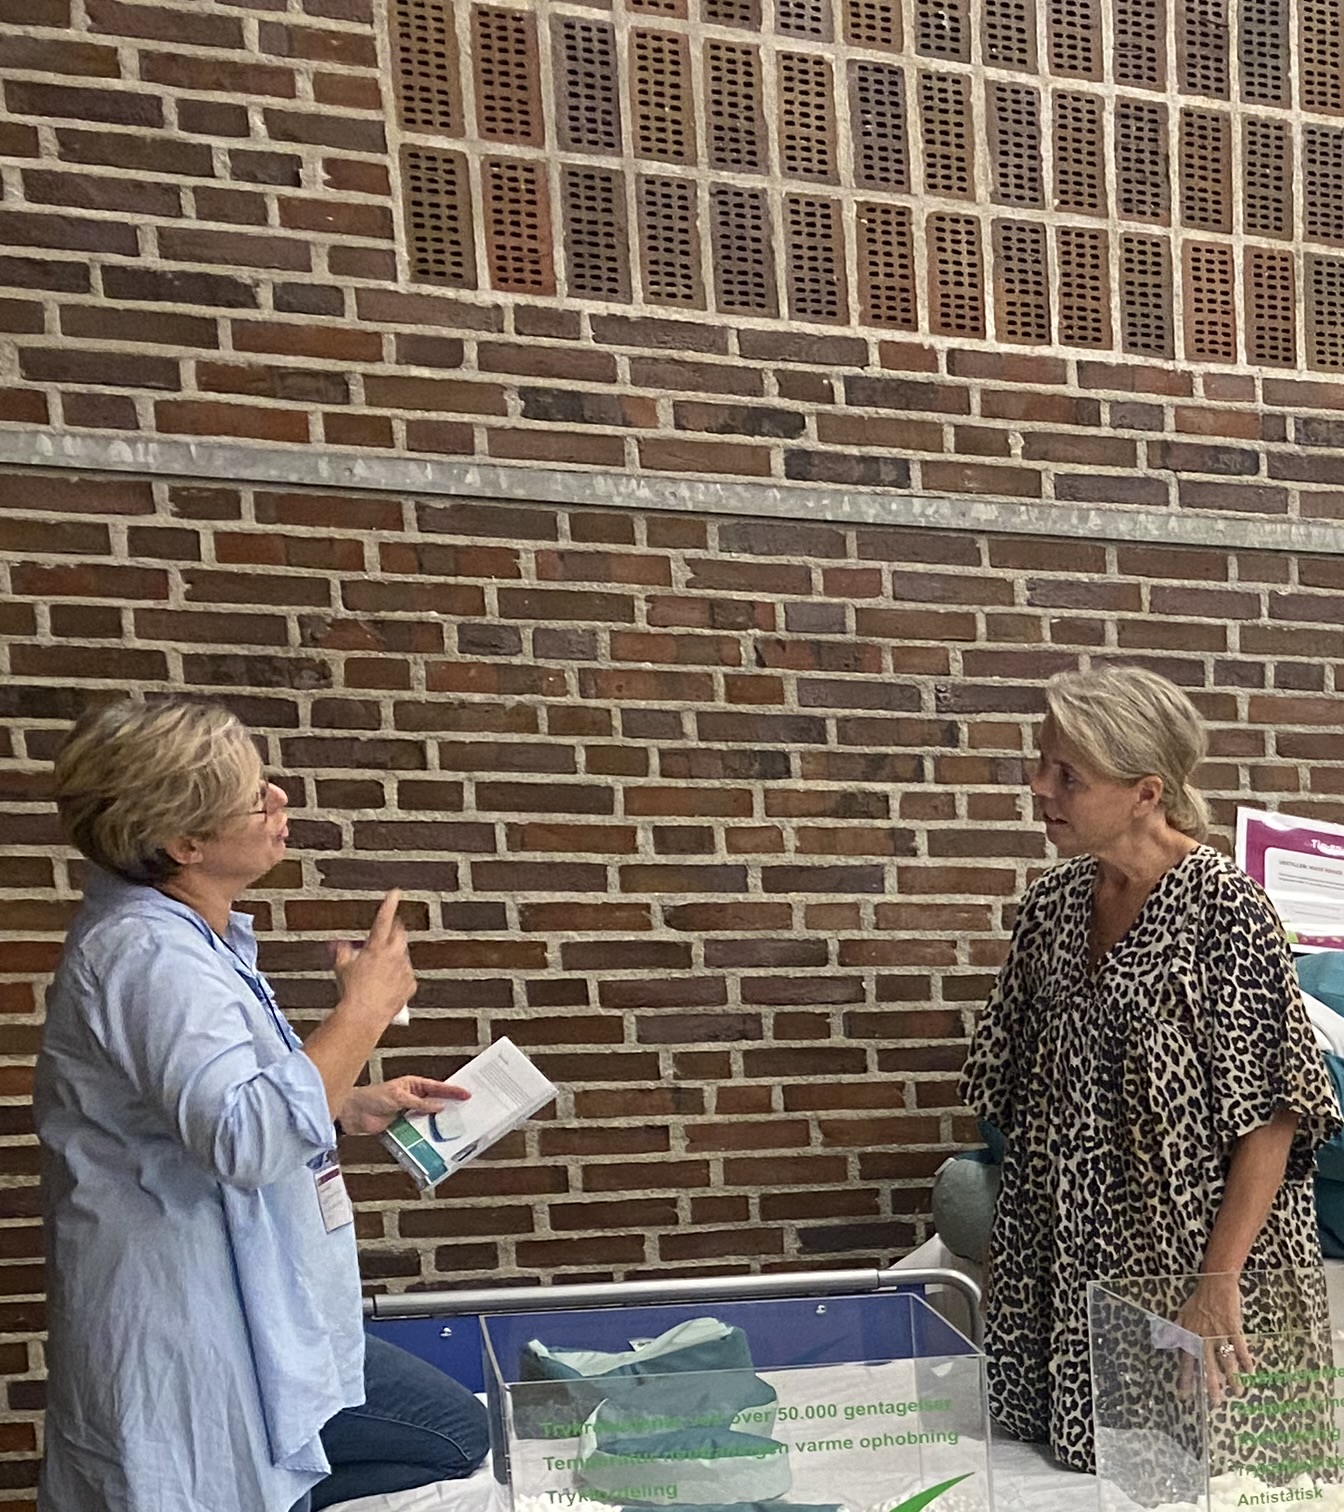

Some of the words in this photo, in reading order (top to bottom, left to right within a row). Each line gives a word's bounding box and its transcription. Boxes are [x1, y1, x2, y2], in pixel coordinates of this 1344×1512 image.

[731, 1409, 772, 1425] over
[777, 1404, 837, 1421] 50.000
[795, 1439, 854, 1453] varme
[860, 1430, 959, 1450] ophobning
[1237, 1487, 1323, 1506] Antistatisk
